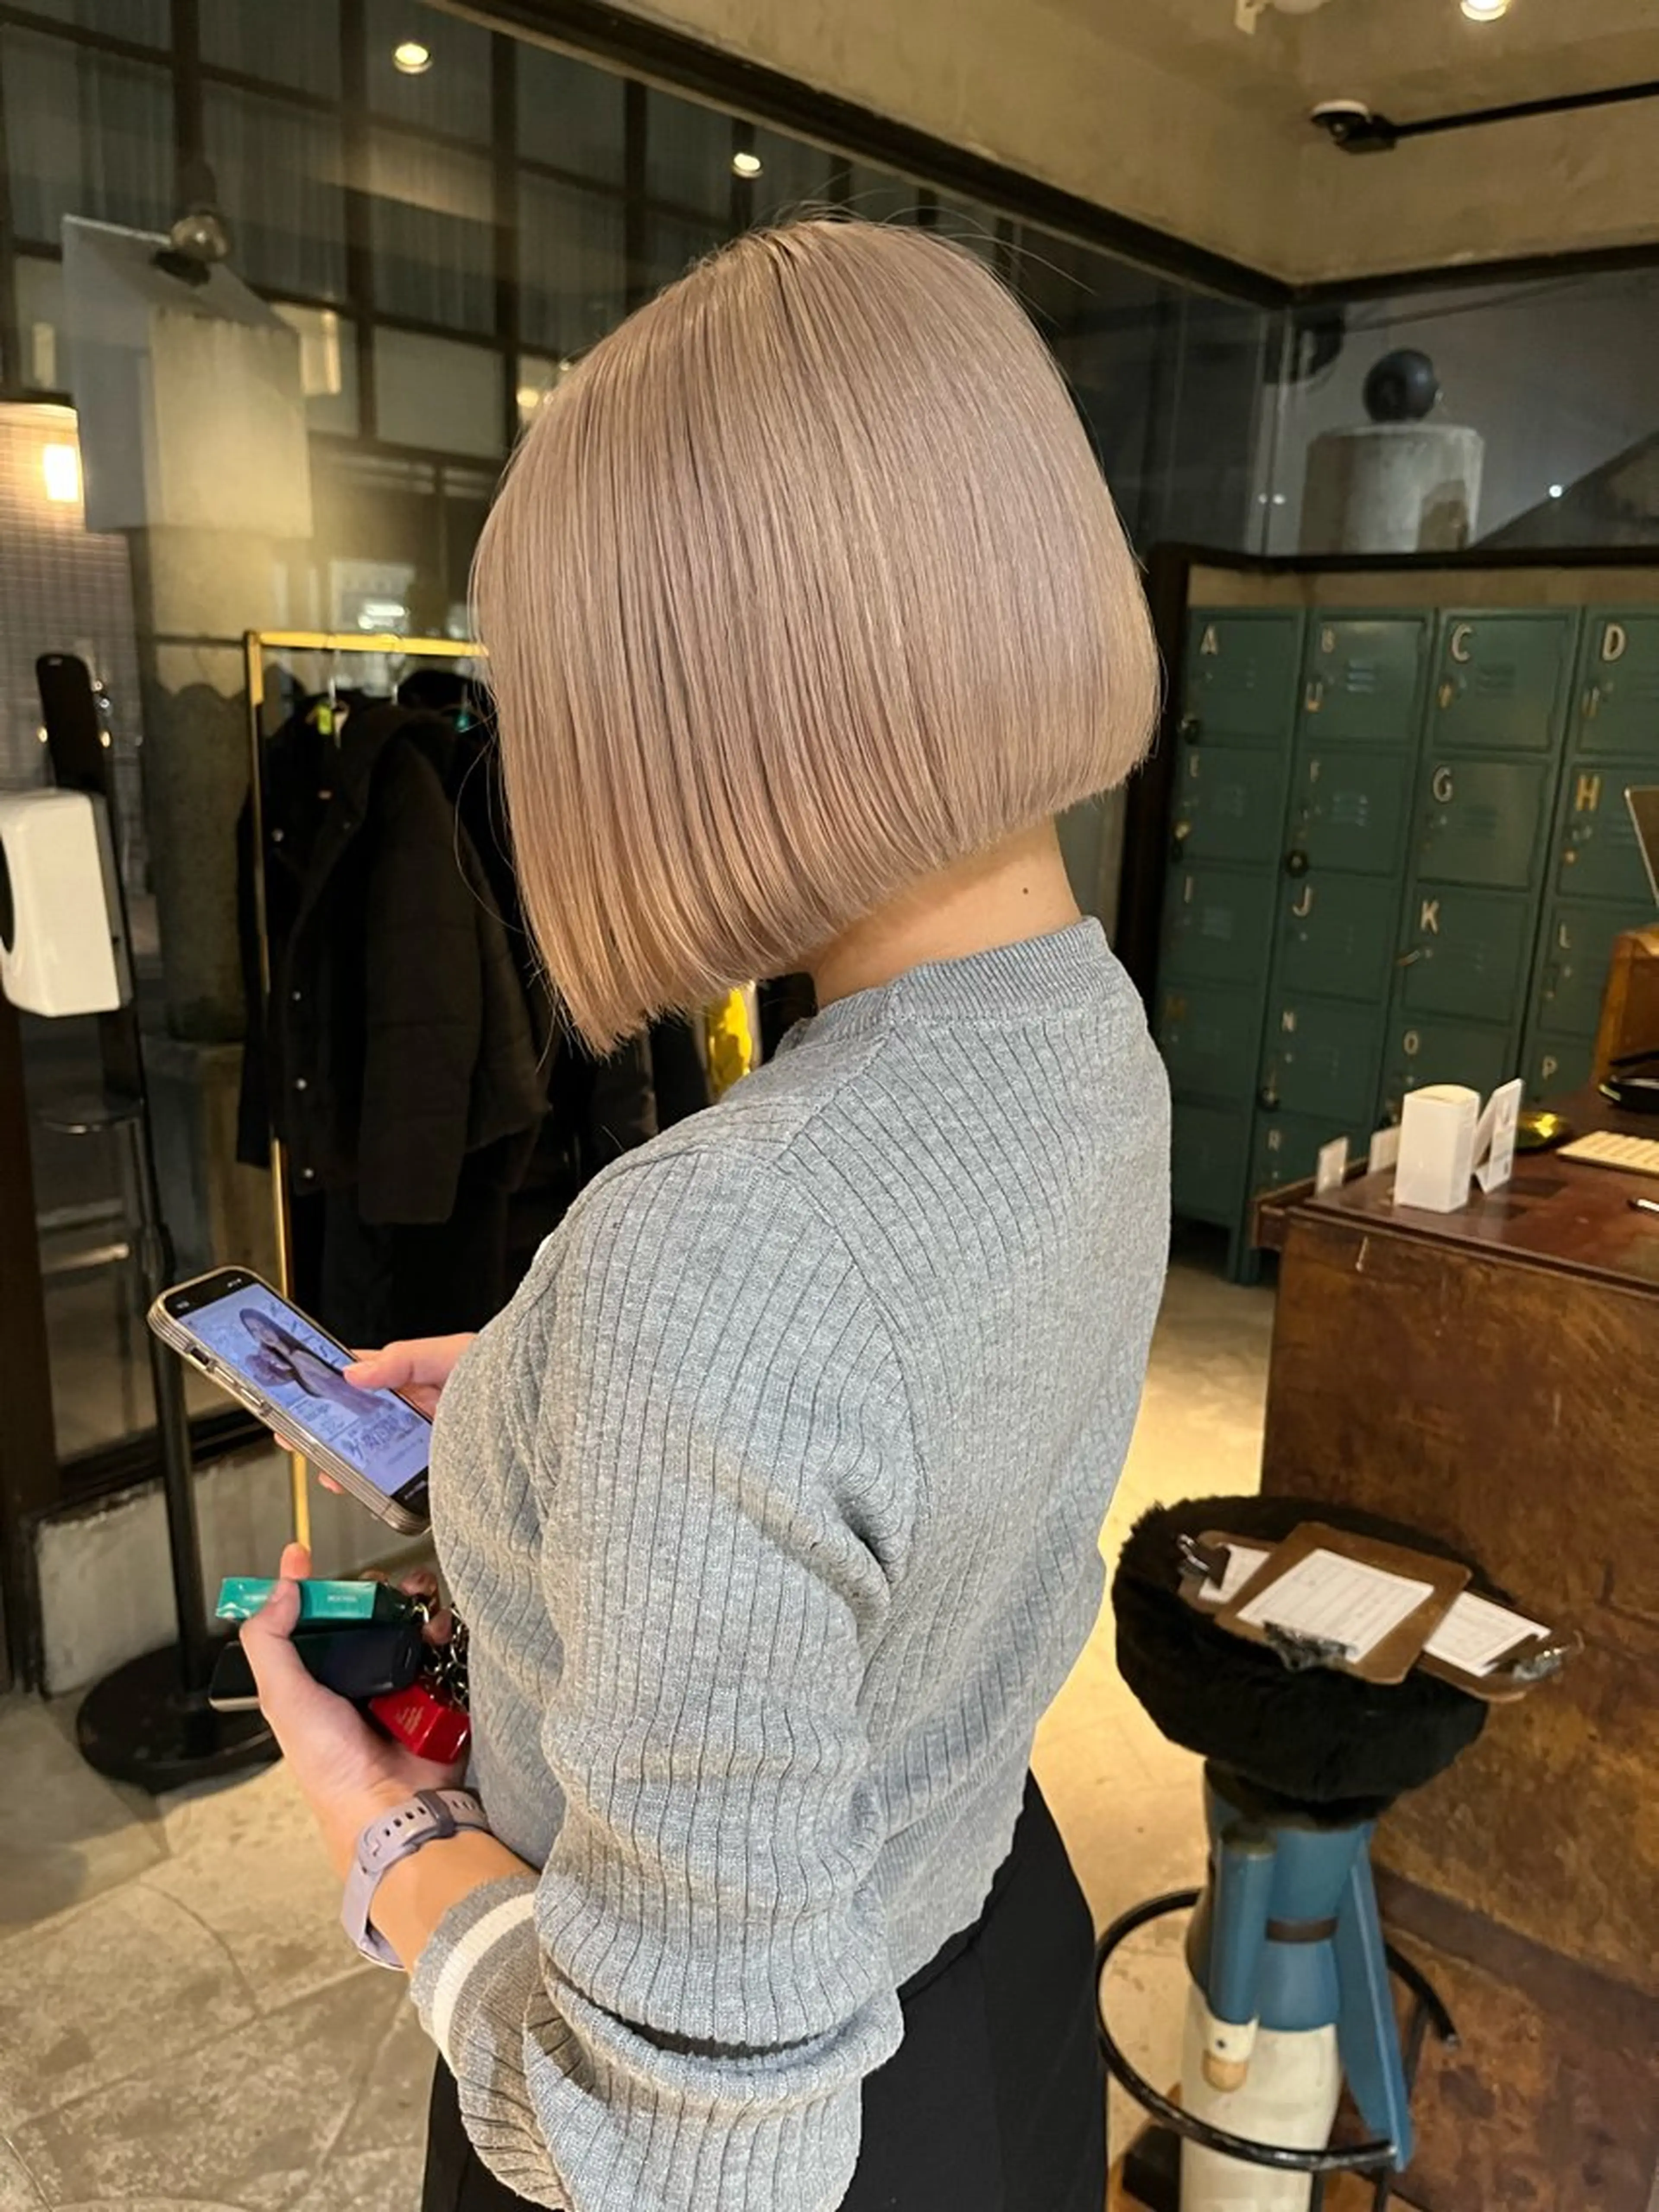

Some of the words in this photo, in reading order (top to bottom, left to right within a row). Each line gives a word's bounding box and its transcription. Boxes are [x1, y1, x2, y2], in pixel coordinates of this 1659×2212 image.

[1201, 625, 1218, 655] A
[1452, 624, 1472, 661] C
[1602, 625, 1626, 661] D
[1433, 766, 1453, 802] G
[1576, 775, 1600, 811] H
[1292, 886, 1312, 917] J
[1420, 900, 1440, 935] K
[1559, 923, 1572, 950] L
[1282, 1011, 1294, 1033] N
[1403, 1030, 1418, 1055] O
[1541, 1055, 1558, 1081] P
